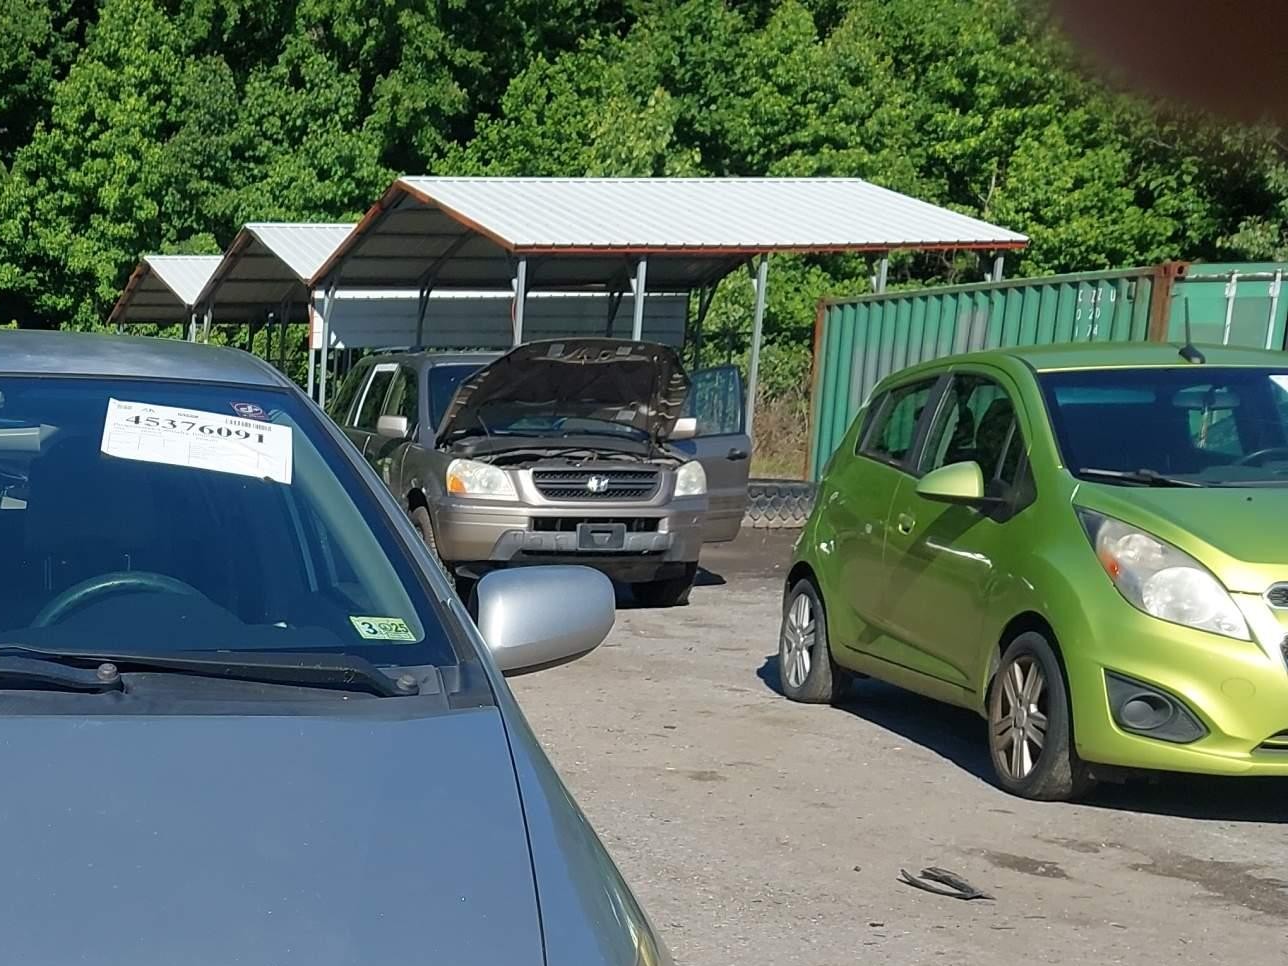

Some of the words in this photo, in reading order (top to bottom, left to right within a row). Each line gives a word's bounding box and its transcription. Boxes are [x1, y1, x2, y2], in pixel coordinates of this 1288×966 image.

[125, 415, 264, 443] 45376091
[361, 622, 378, 635] 3
[391, 622, 409, 633] 25
